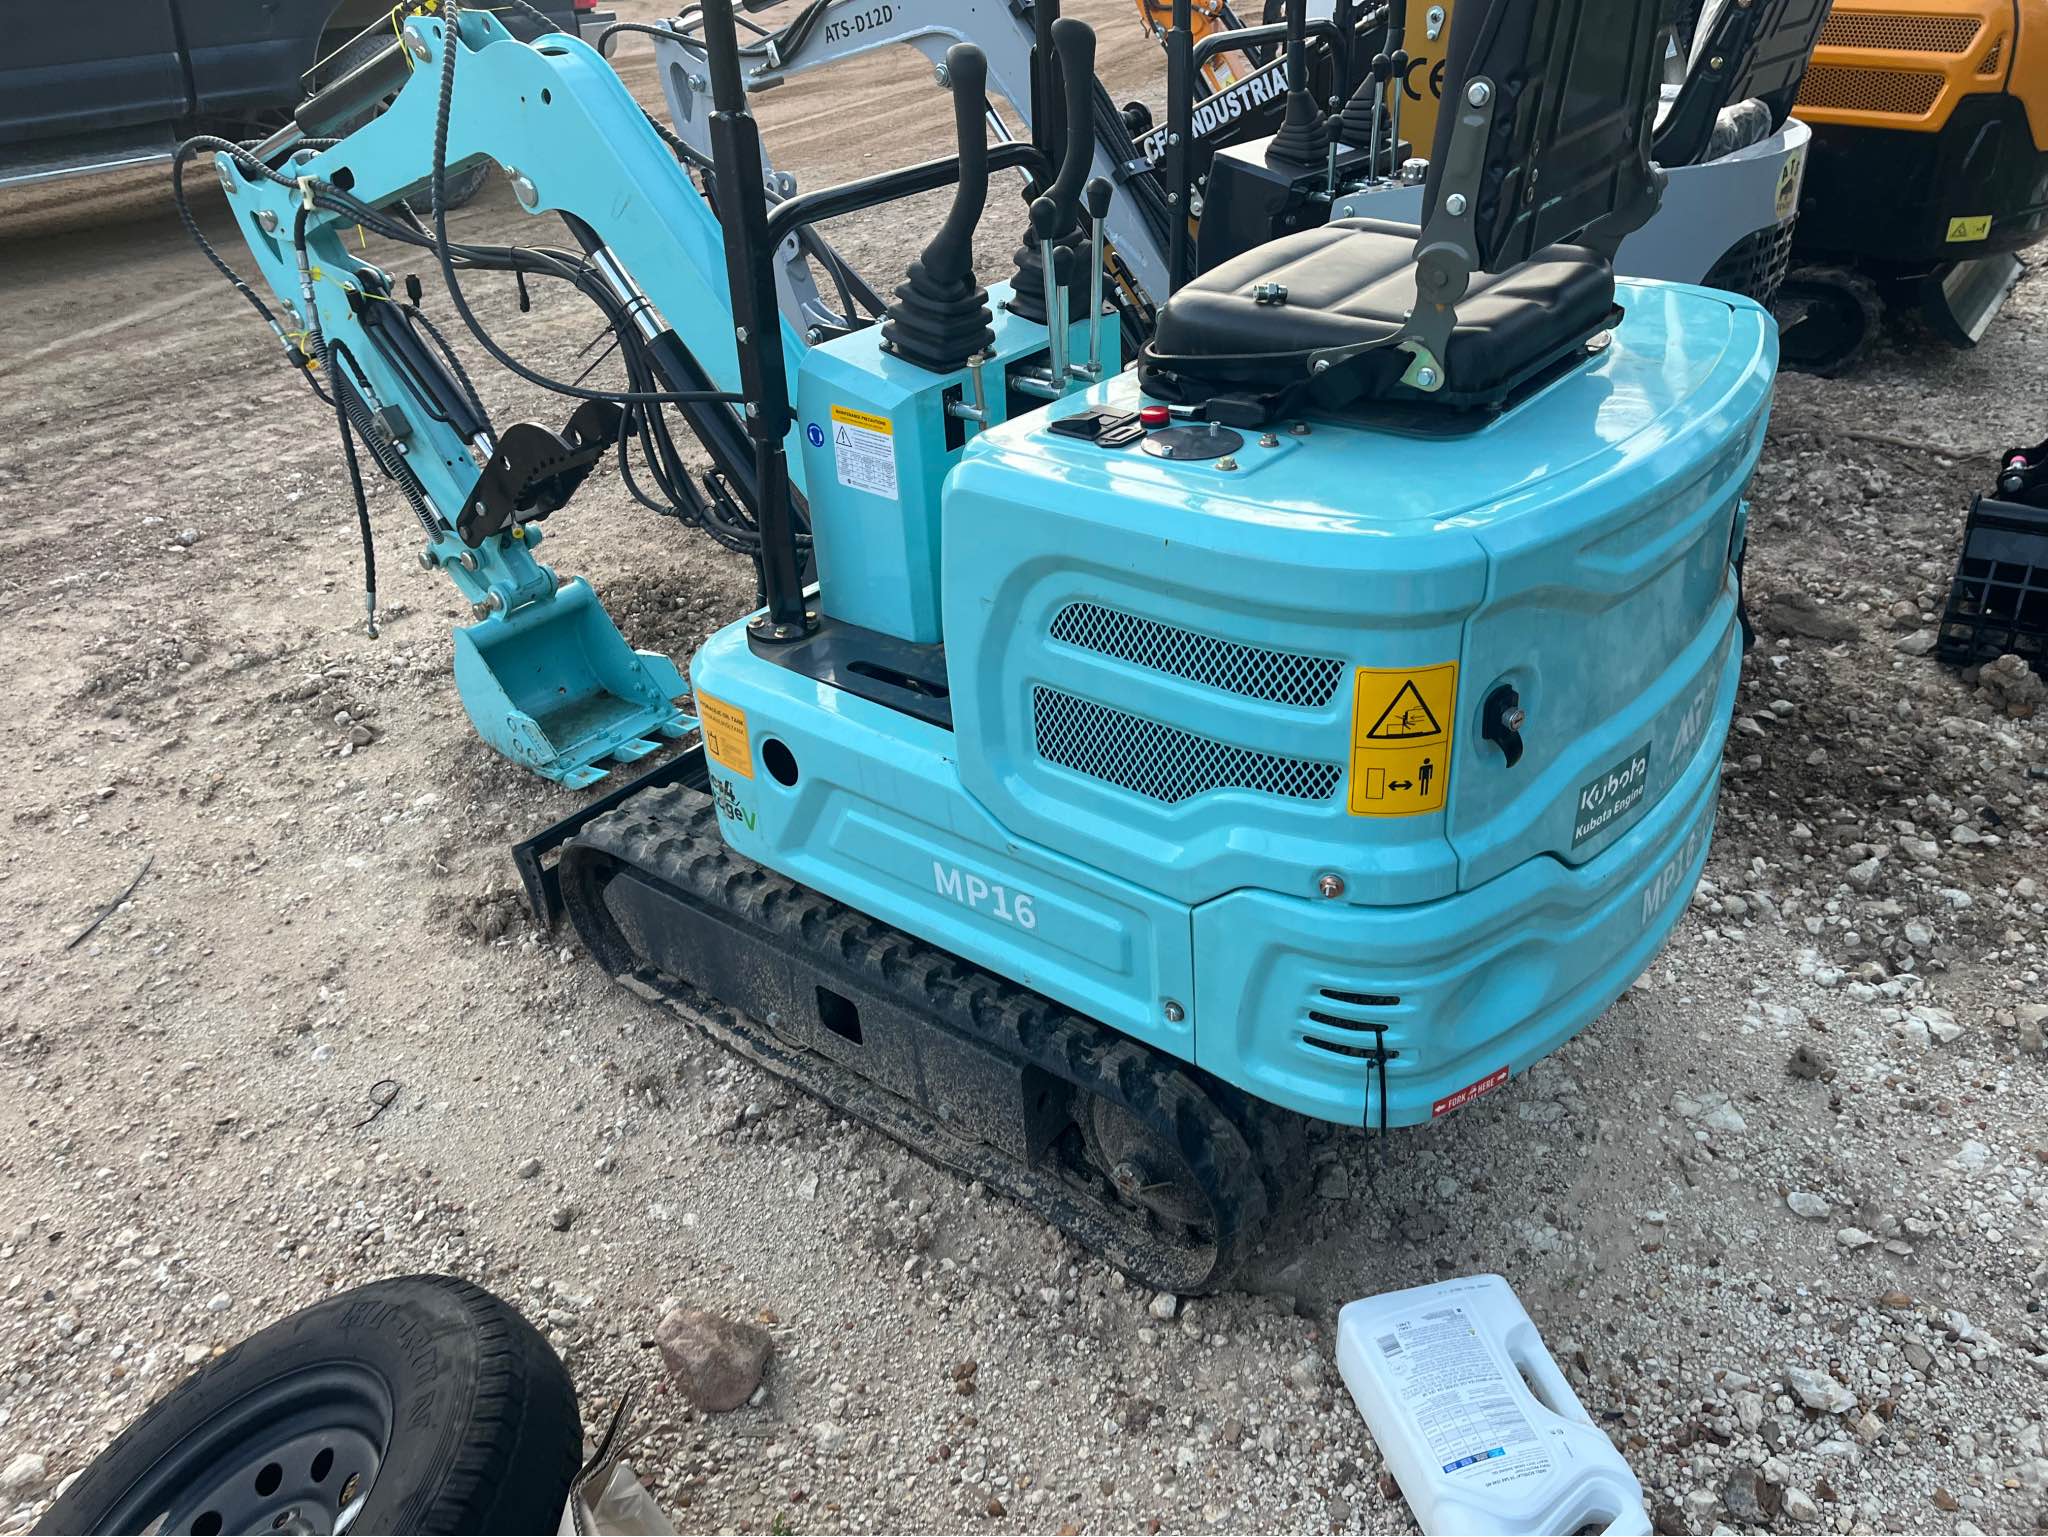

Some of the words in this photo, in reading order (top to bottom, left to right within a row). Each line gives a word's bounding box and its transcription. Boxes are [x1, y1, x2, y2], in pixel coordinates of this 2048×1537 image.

[825, 4, 893, 44] ATS-D12D
[1192, 62, 1289, 139] NDUSTRIA
[1575, 808, 1613, 840] Kubota
[1613, 784, 1644, 815] Engine
[1581, 757, 1646, 811] Kubota
[933, 861, 1037, 930] MP16
[1641, 829, 1697, 925] MP16
[1448, 1091, 1468, 1109] FORK
[1477, 1076, 1496, 1093] HERE
